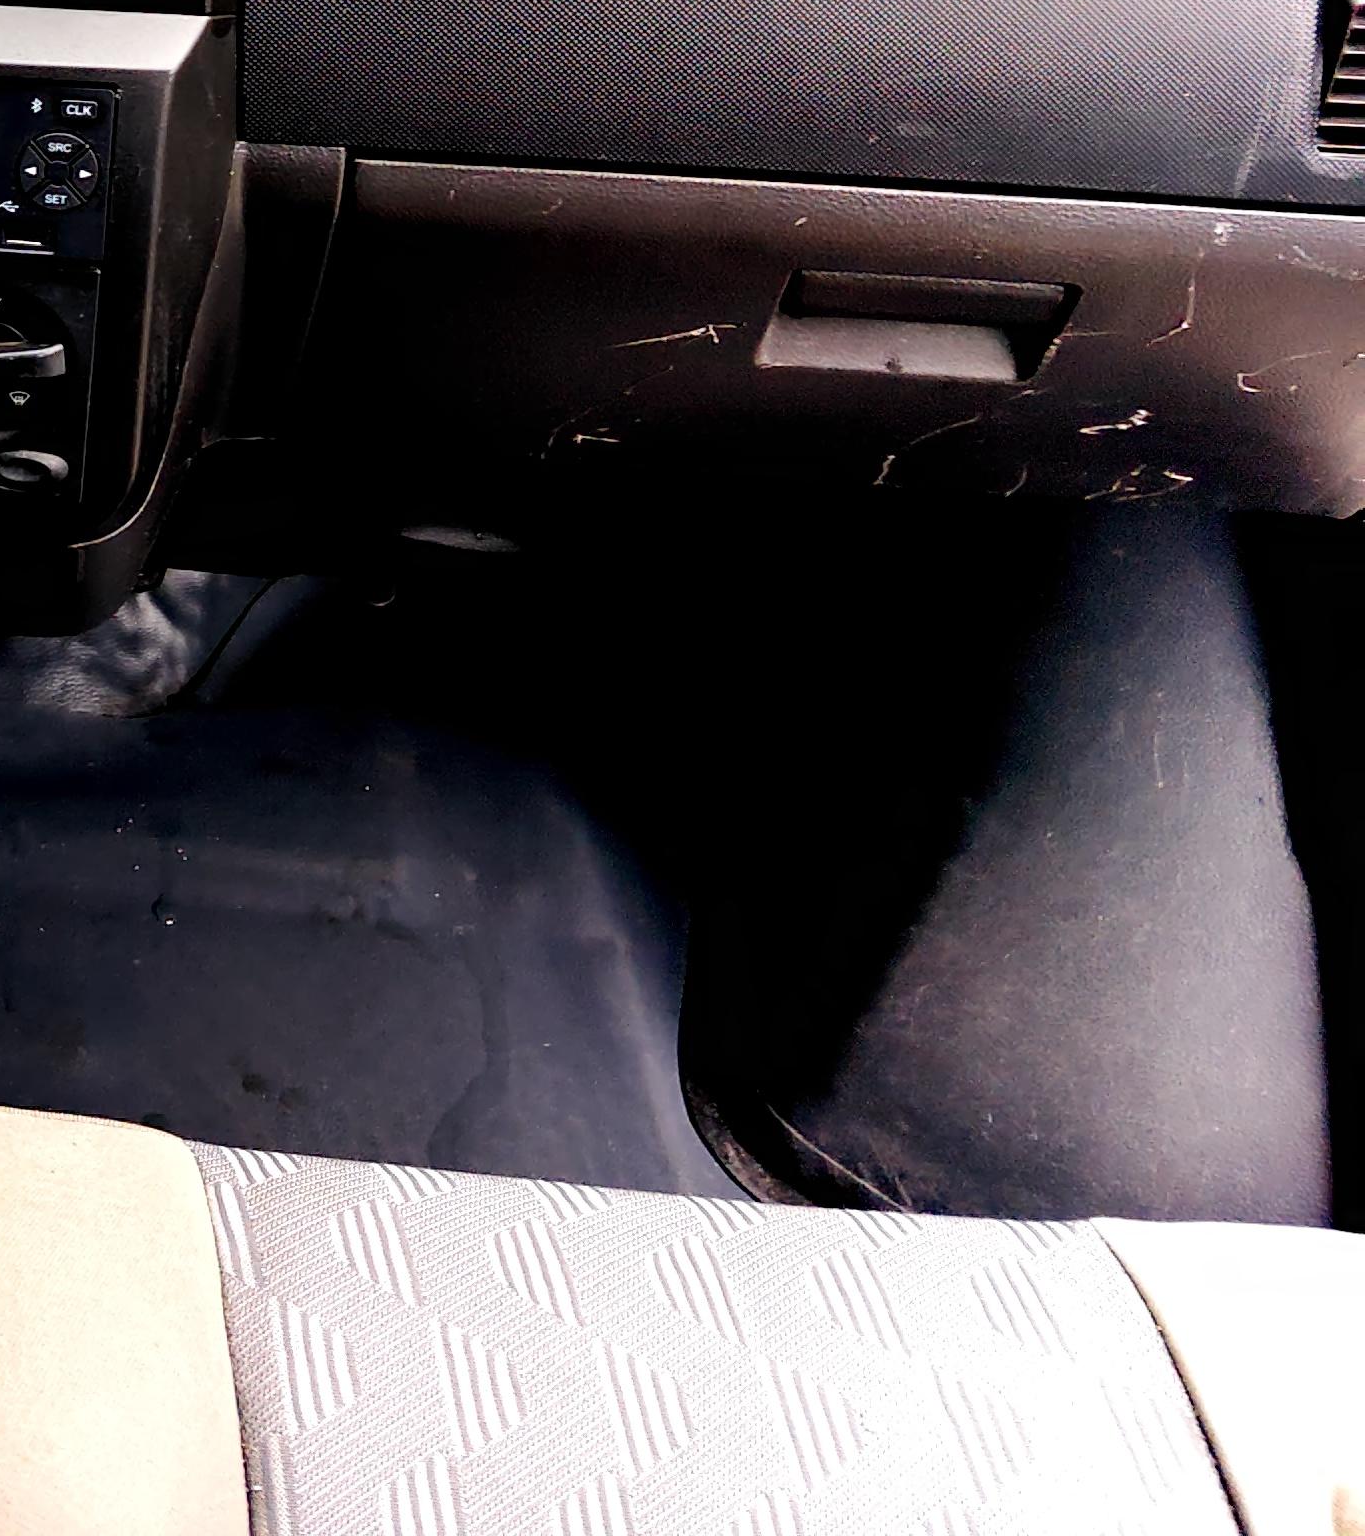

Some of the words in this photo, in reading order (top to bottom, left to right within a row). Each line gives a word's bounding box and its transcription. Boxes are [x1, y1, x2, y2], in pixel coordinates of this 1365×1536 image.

[65, 104, 93, 117] CLK
[47, 141, 72, 154] SRC
[44, 193, 68, 205] SET
